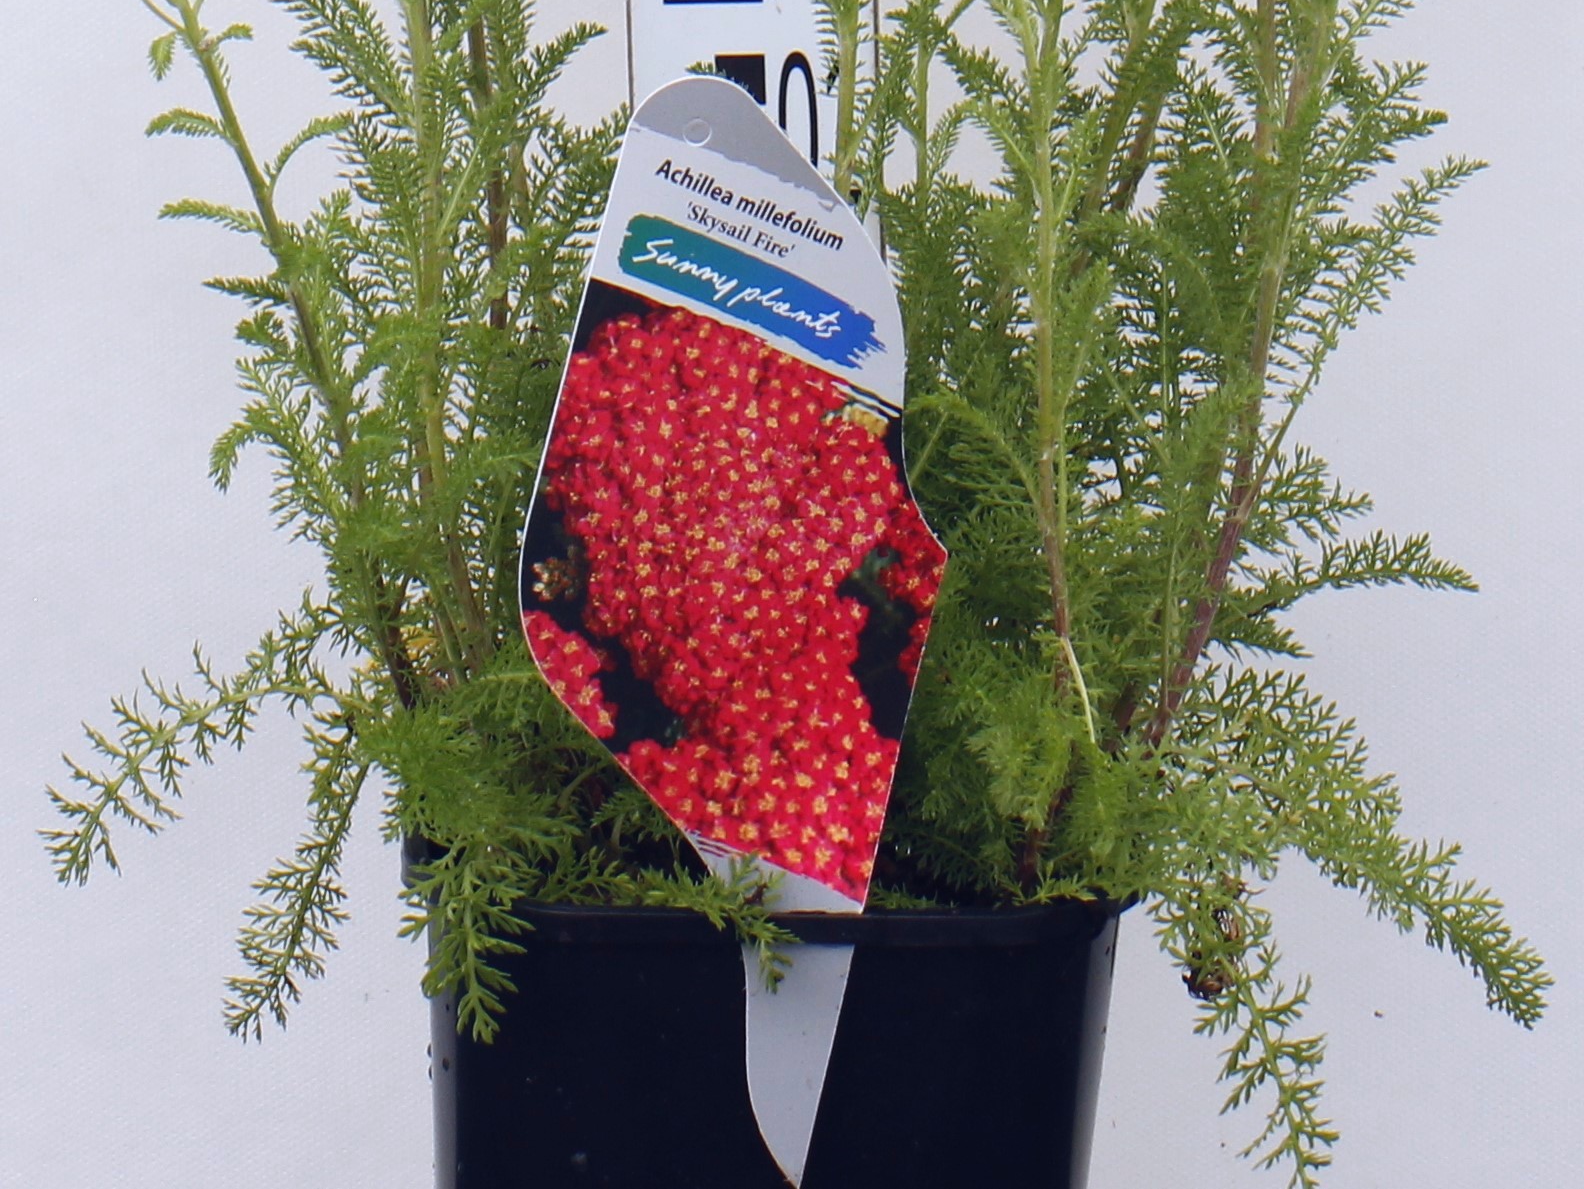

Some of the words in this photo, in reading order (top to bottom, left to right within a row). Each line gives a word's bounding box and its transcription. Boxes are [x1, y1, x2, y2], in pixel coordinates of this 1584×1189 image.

[655, 158, 733, 206] Achillea
[736, 192, 844, 251] millefolium
[632, 239, 738, 300] Sunny
[727, 285, 842, 339] plants
